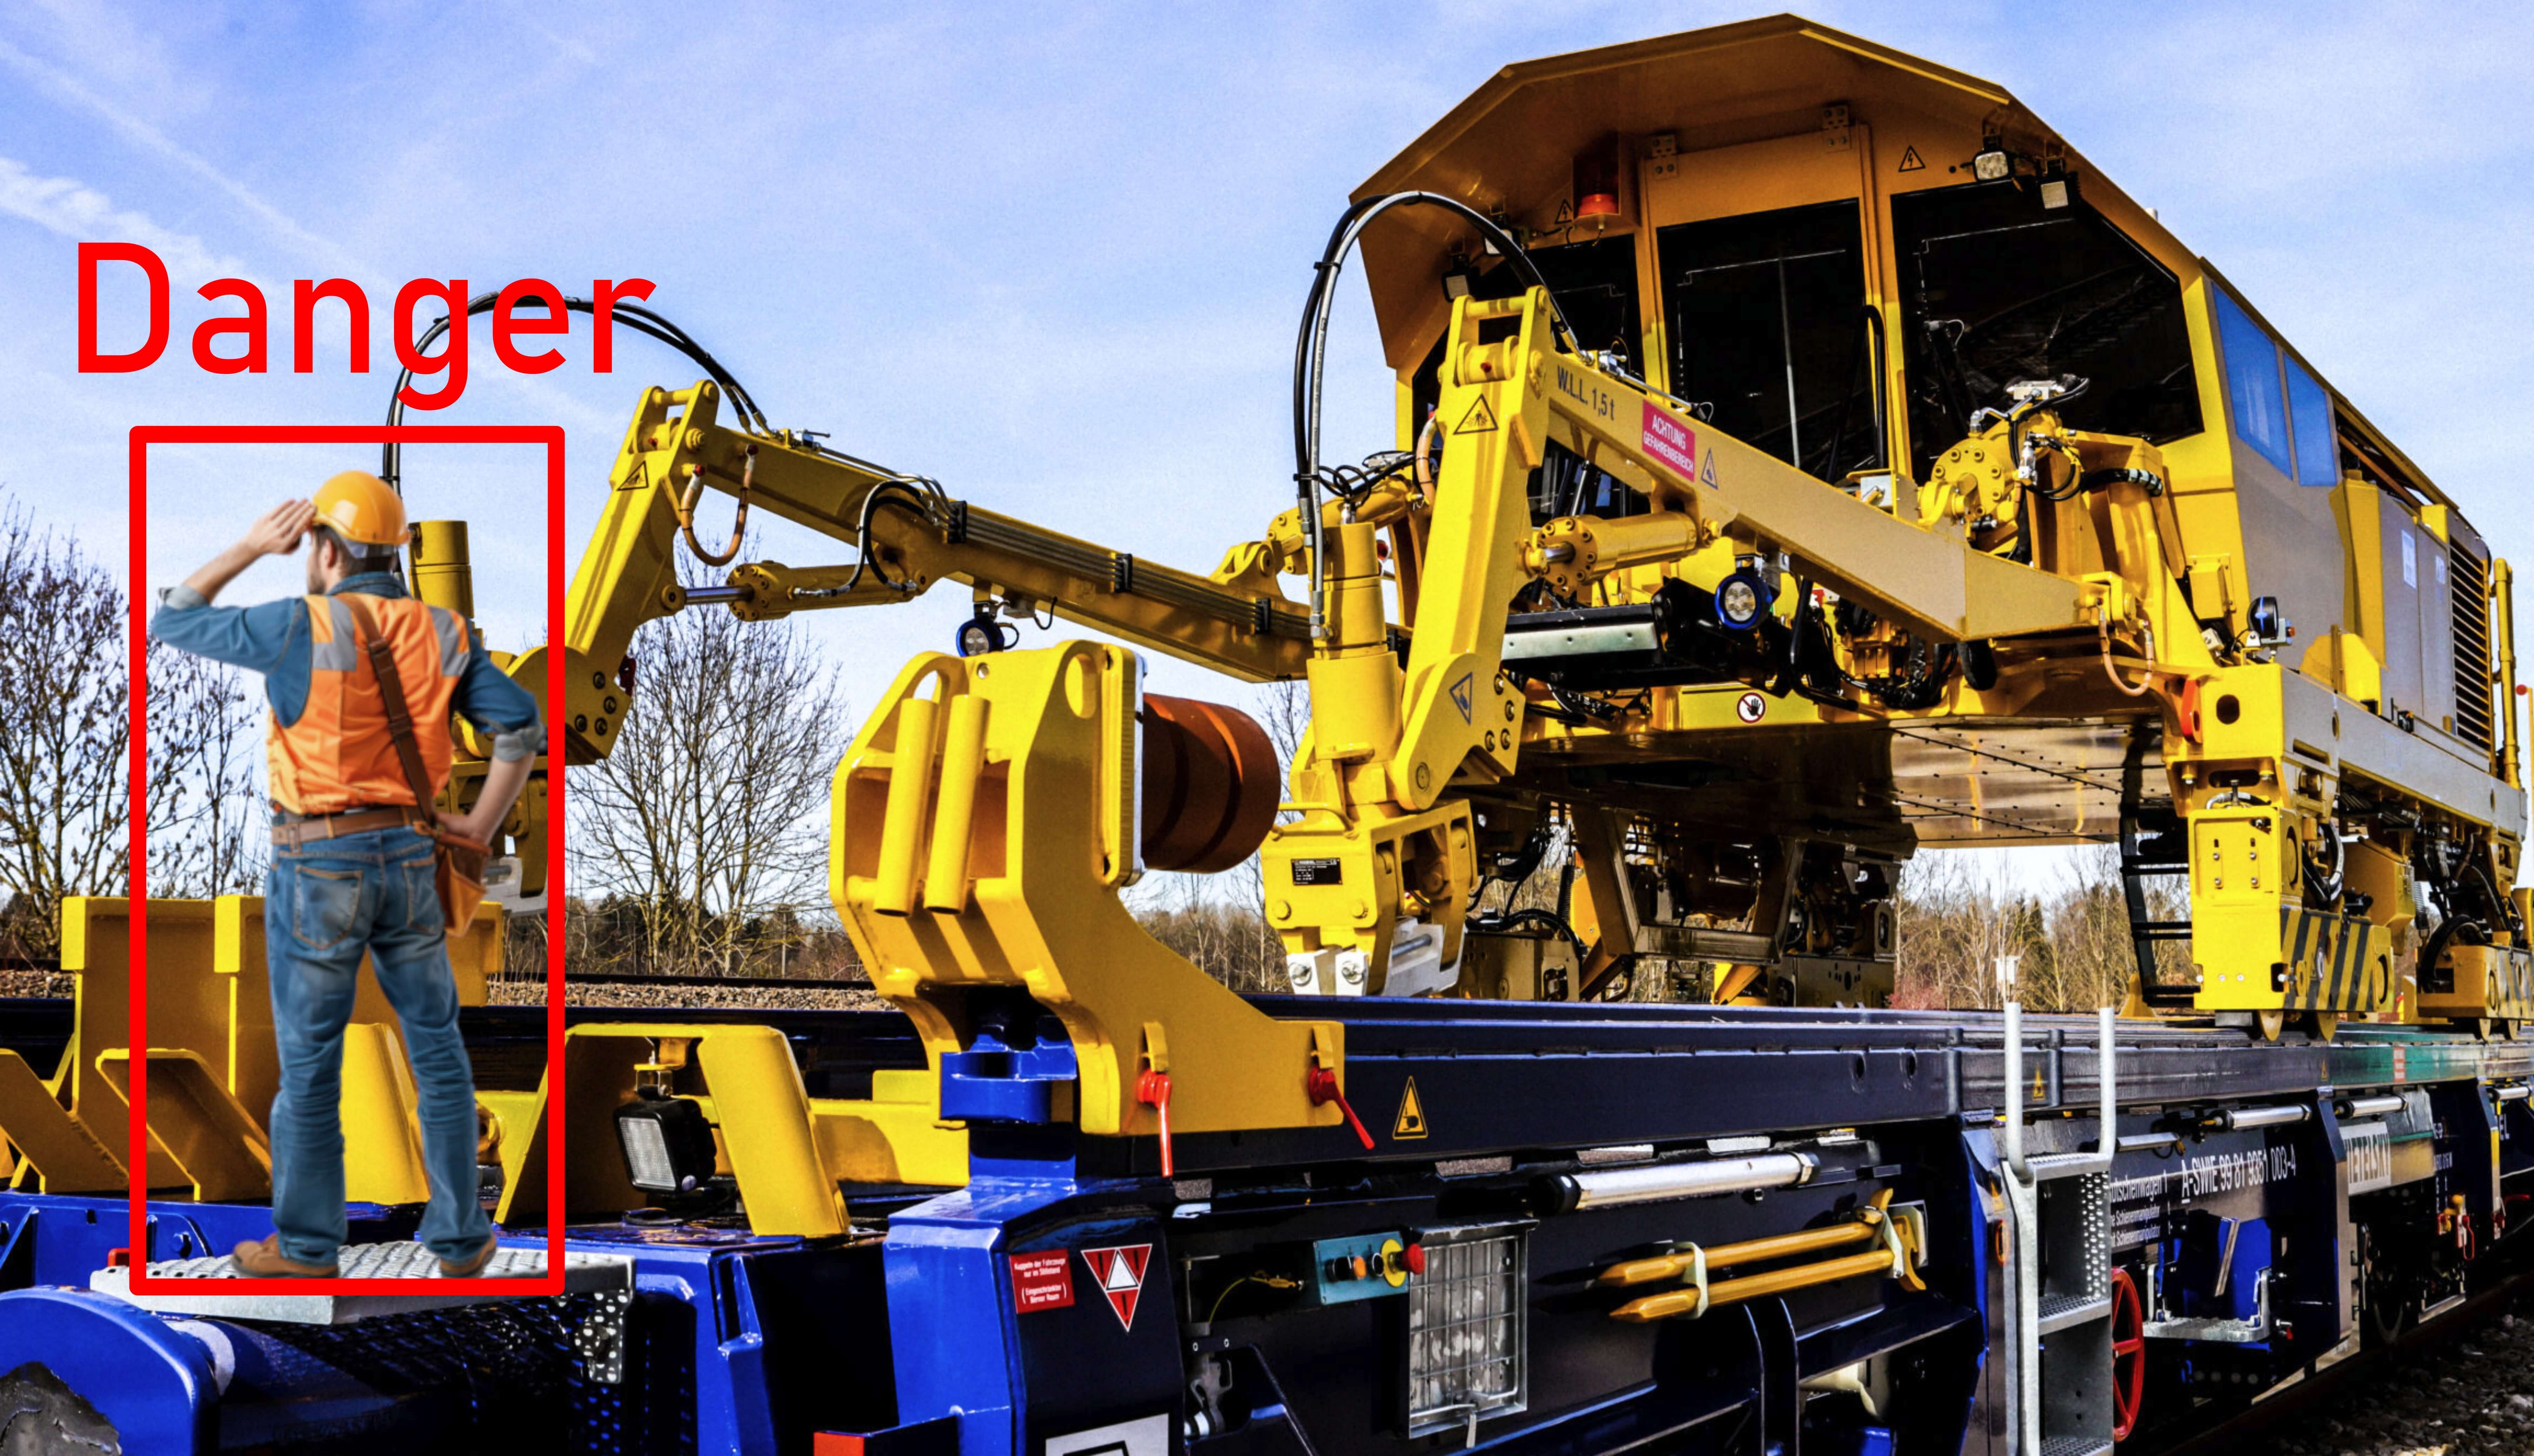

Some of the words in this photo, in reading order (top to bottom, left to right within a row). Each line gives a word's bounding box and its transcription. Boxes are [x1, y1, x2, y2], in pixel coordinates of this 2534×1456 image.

[1558, 365, 1588, 405] W.L.L.
[1592, 388, 1607, 417] 1,5
[1610, 399, 1614, 420] t
[1643, 431, 1693, 473] GEFAHRENBEREICH
[1652, 414, 1686, 450] ACHTUNG
[2181, 1155, 2218, 1197] A-SWIE
[2219, 1154, 2233, 1191] 99
[2234, 1152, 2245, 1189] 81
[2247, 1149, 2268, 1187] 9351
[2270, 1144, 2296, 1181] 003-4
[2344, 1133, 2389, 1184] IETELSKY
